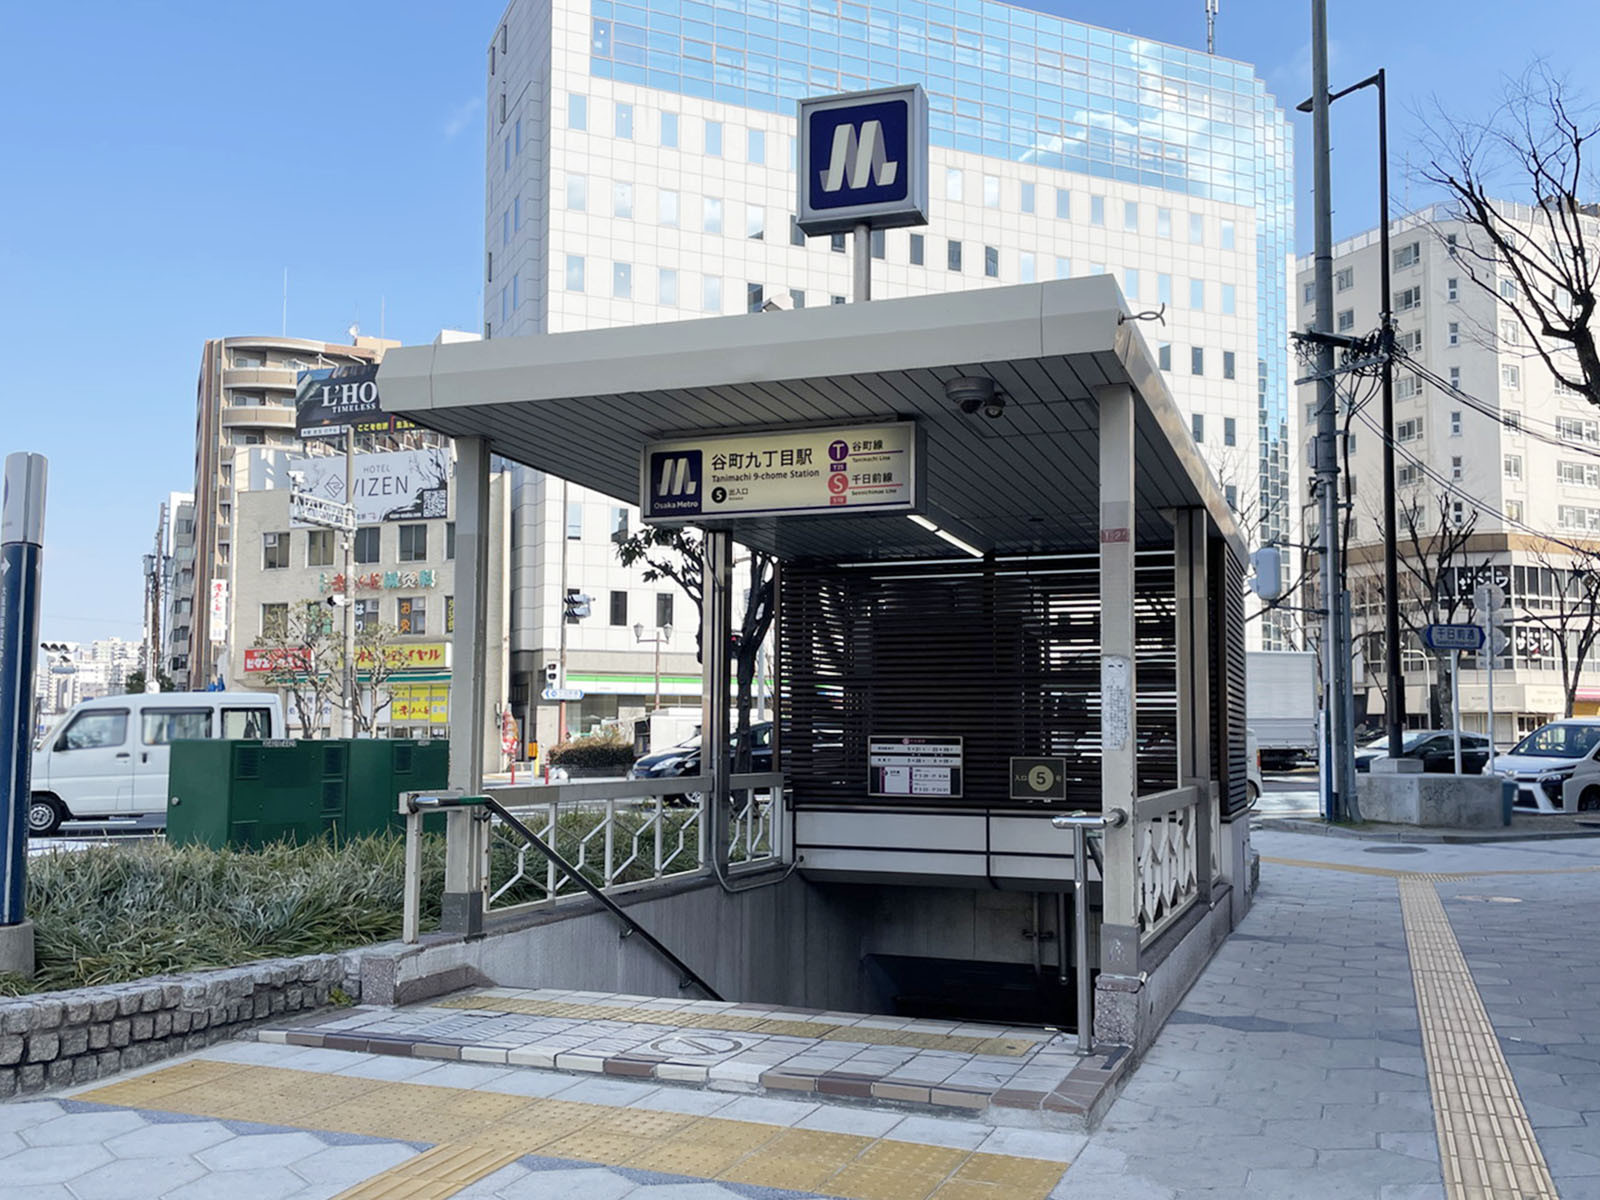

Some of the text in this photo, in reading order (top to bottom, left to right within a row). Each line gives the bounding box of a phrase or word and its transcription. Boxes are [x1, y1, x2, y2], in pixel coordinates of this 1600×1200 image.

[332, 403, 376, 413] TIMELESS
[852, 440, 883, 451] 谷町線
[711, 448, 813, 471] 谷町九丁目駅
[363, 464, 391, 474] HOTEL
[712, 469, 820, 482] Tanimachi 9-chome Station
[852, 472, 893, 484] 千日前線
[728, 488, 748, 496] 出入口
[654, 501, 676, 509] Osaka
[1036, 771, 1046, 785] 5
